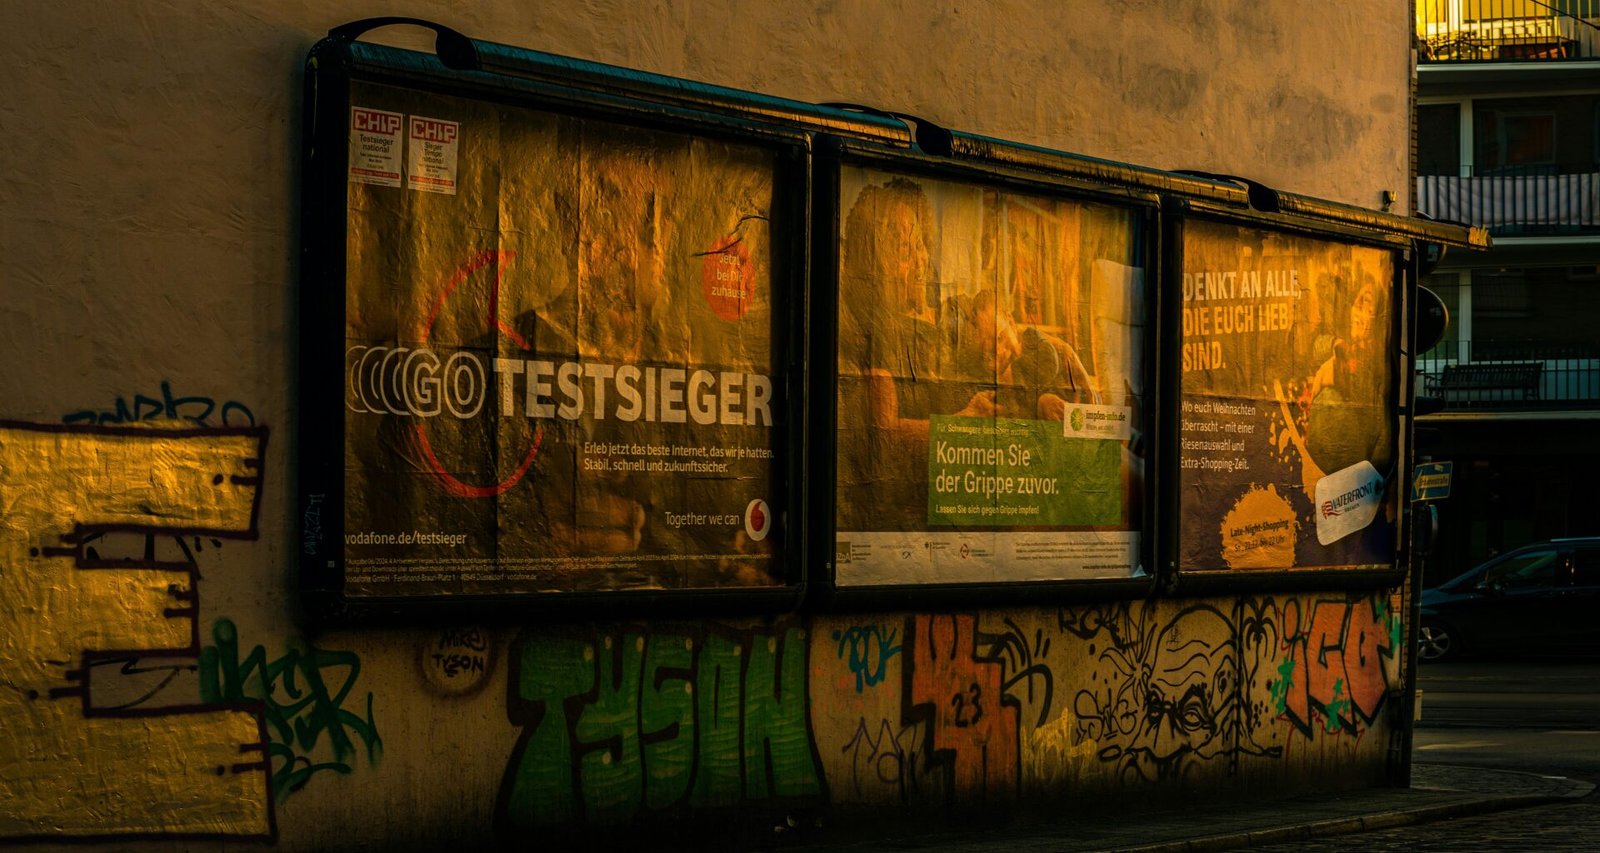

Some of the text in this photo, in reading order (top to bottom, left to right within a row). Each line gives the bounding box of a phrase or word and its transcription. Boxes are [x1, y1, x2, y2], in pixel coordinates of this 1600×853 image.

[354, 110, 400, 135] CHIP
[412, 120, 457, 142] CHIP
[360, 134, 394, 146] Testsieger
[362, 144, 390, 153] national
[716, 268, 730, 281] bei
[712, 286, 746, 299] zuhause
[1184, 272, 1236, 301] DENKT
[1240, 270, 1261, 298] AN
[1183, 308, 1210, 336] DIE
[1214, 304, 1254, 334] EUCH
[1183, 341, 1226, 372] SIND.
[494, 358, 772, 427] TESTSIEGER
[1181, 400, 1256, 416] Wo euch Weihnachten
[1224, 422, 1237, 432] mit
[1238, 422, 1255, 434] einer
[584, 442, 774, 460] Erleb jetzt das beste Internet, das wir je hatten.
[936, 441, 1030, 466] Kommen Sie
[1232, 440, 1244, 452] und
[584, 458, 728, 472] Stabil, schnell und zukunftssicher.
[1181, 456, 1250, 472] Extra-Shopping-Zeit.
[936, 469, 1059, 500] der Grippe zuvor.
[1332, 482, 1372, 509] WATERFRONT
[936, 504, 1040, 516] Lassen Sie sich gegen Grippe impfen!
[664, 511, 740, 528] Together we can
[344, 530, 467, 547] vodafone.de/testsieger
[952, 682, 983, 728] 23
[500, 622, 830, 830] TYSON
